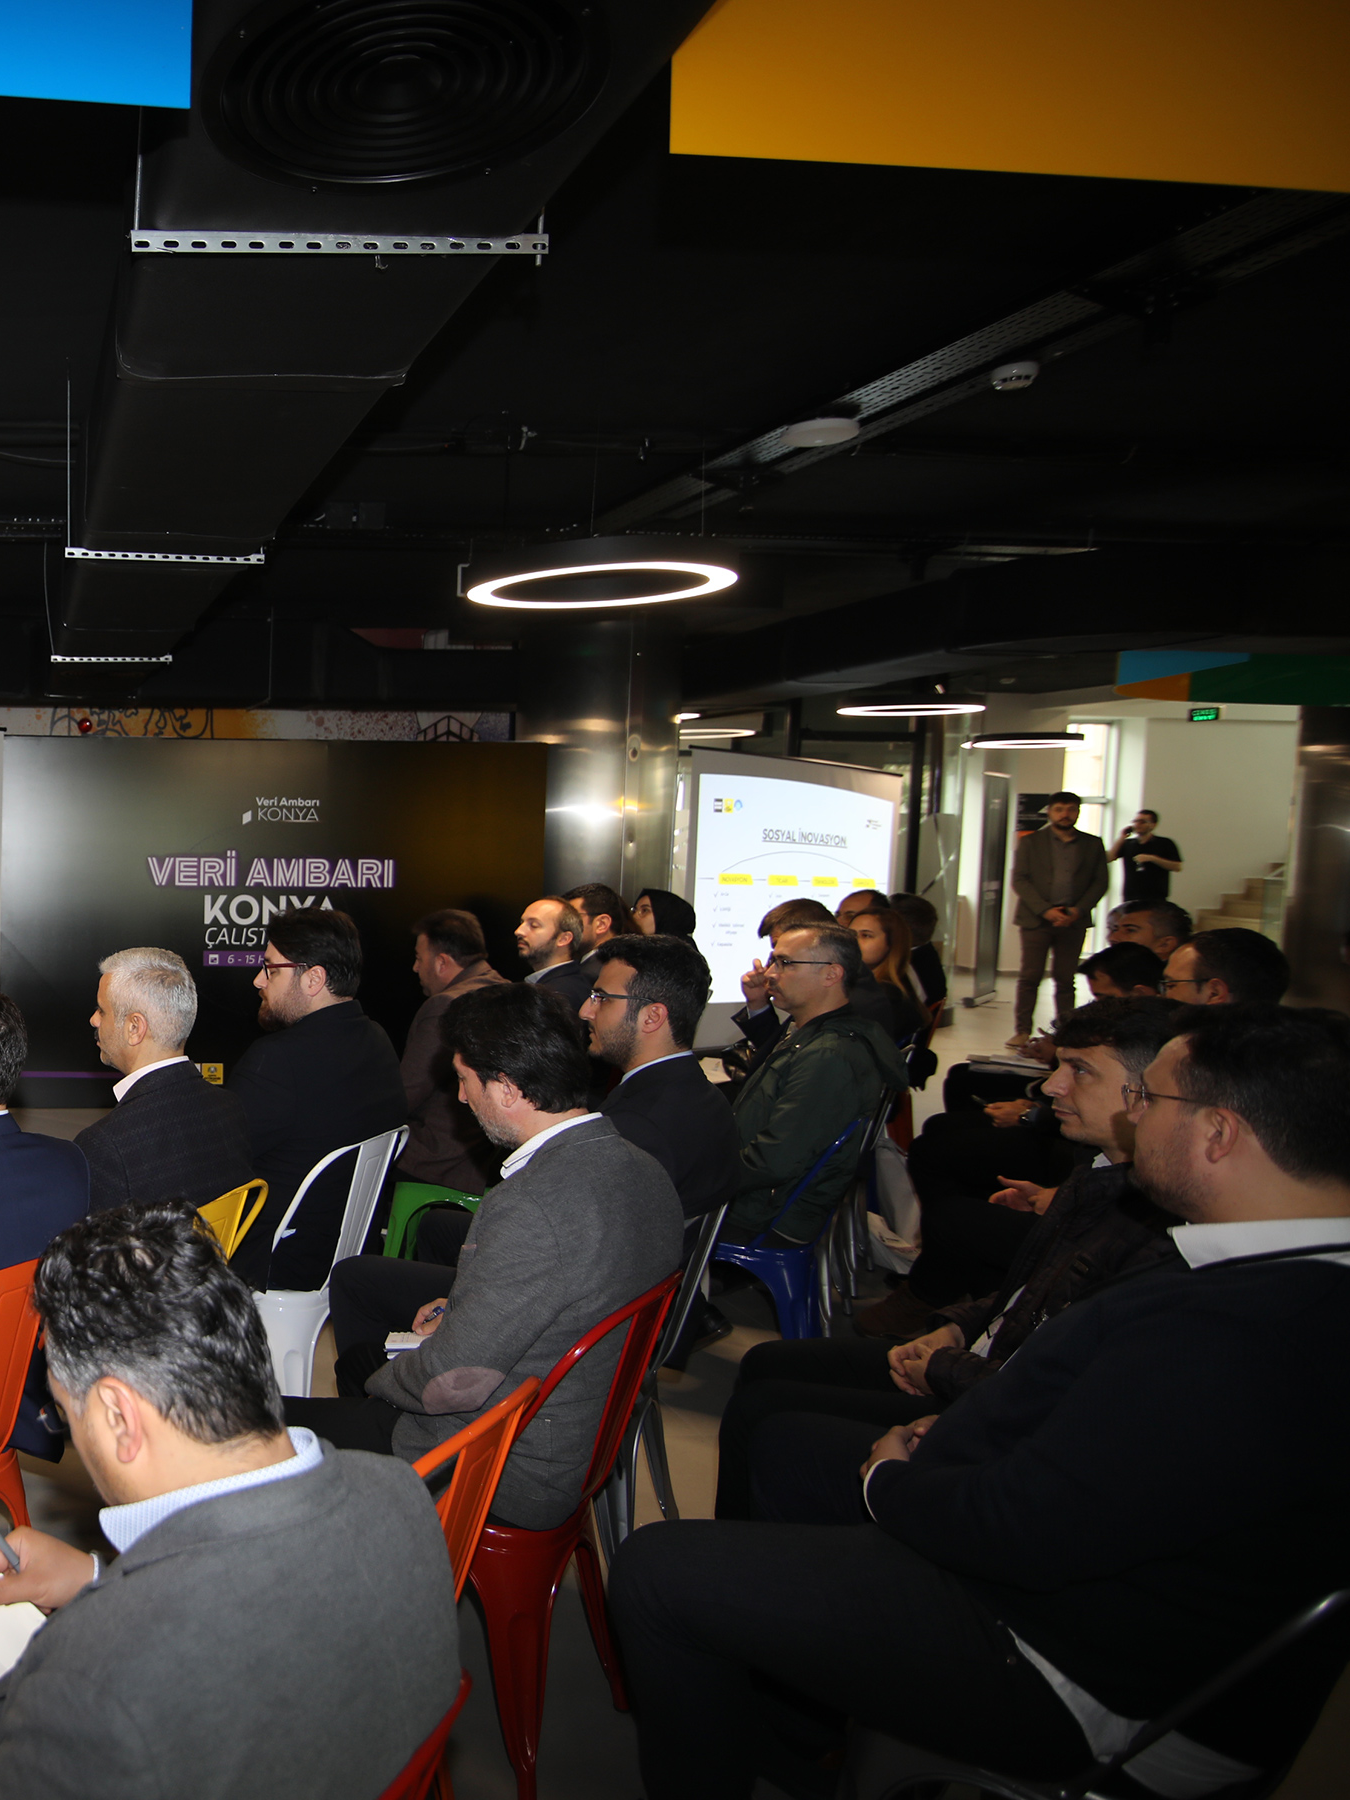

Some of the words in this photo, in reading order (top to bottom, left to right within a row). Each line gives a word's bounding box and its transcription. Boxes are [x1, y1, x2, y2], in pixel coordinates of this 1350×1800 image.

[256, 797, 277, 806] Veri
[279, 797, 319, 807] Ambarı
[258, 807, 319, 821] KONYA
[762, 829, 796, 842] SOSYAL
[798, 828, 847, 846] İNOVASYON
[148, 850, 236, 887] VERİ
[245, 858, 394, 888] AMBARI
[205, 927, 268, 949] ÇALIŞT
[227, 954, 235, 964] 6
[245, 954, 255, 964] 15
